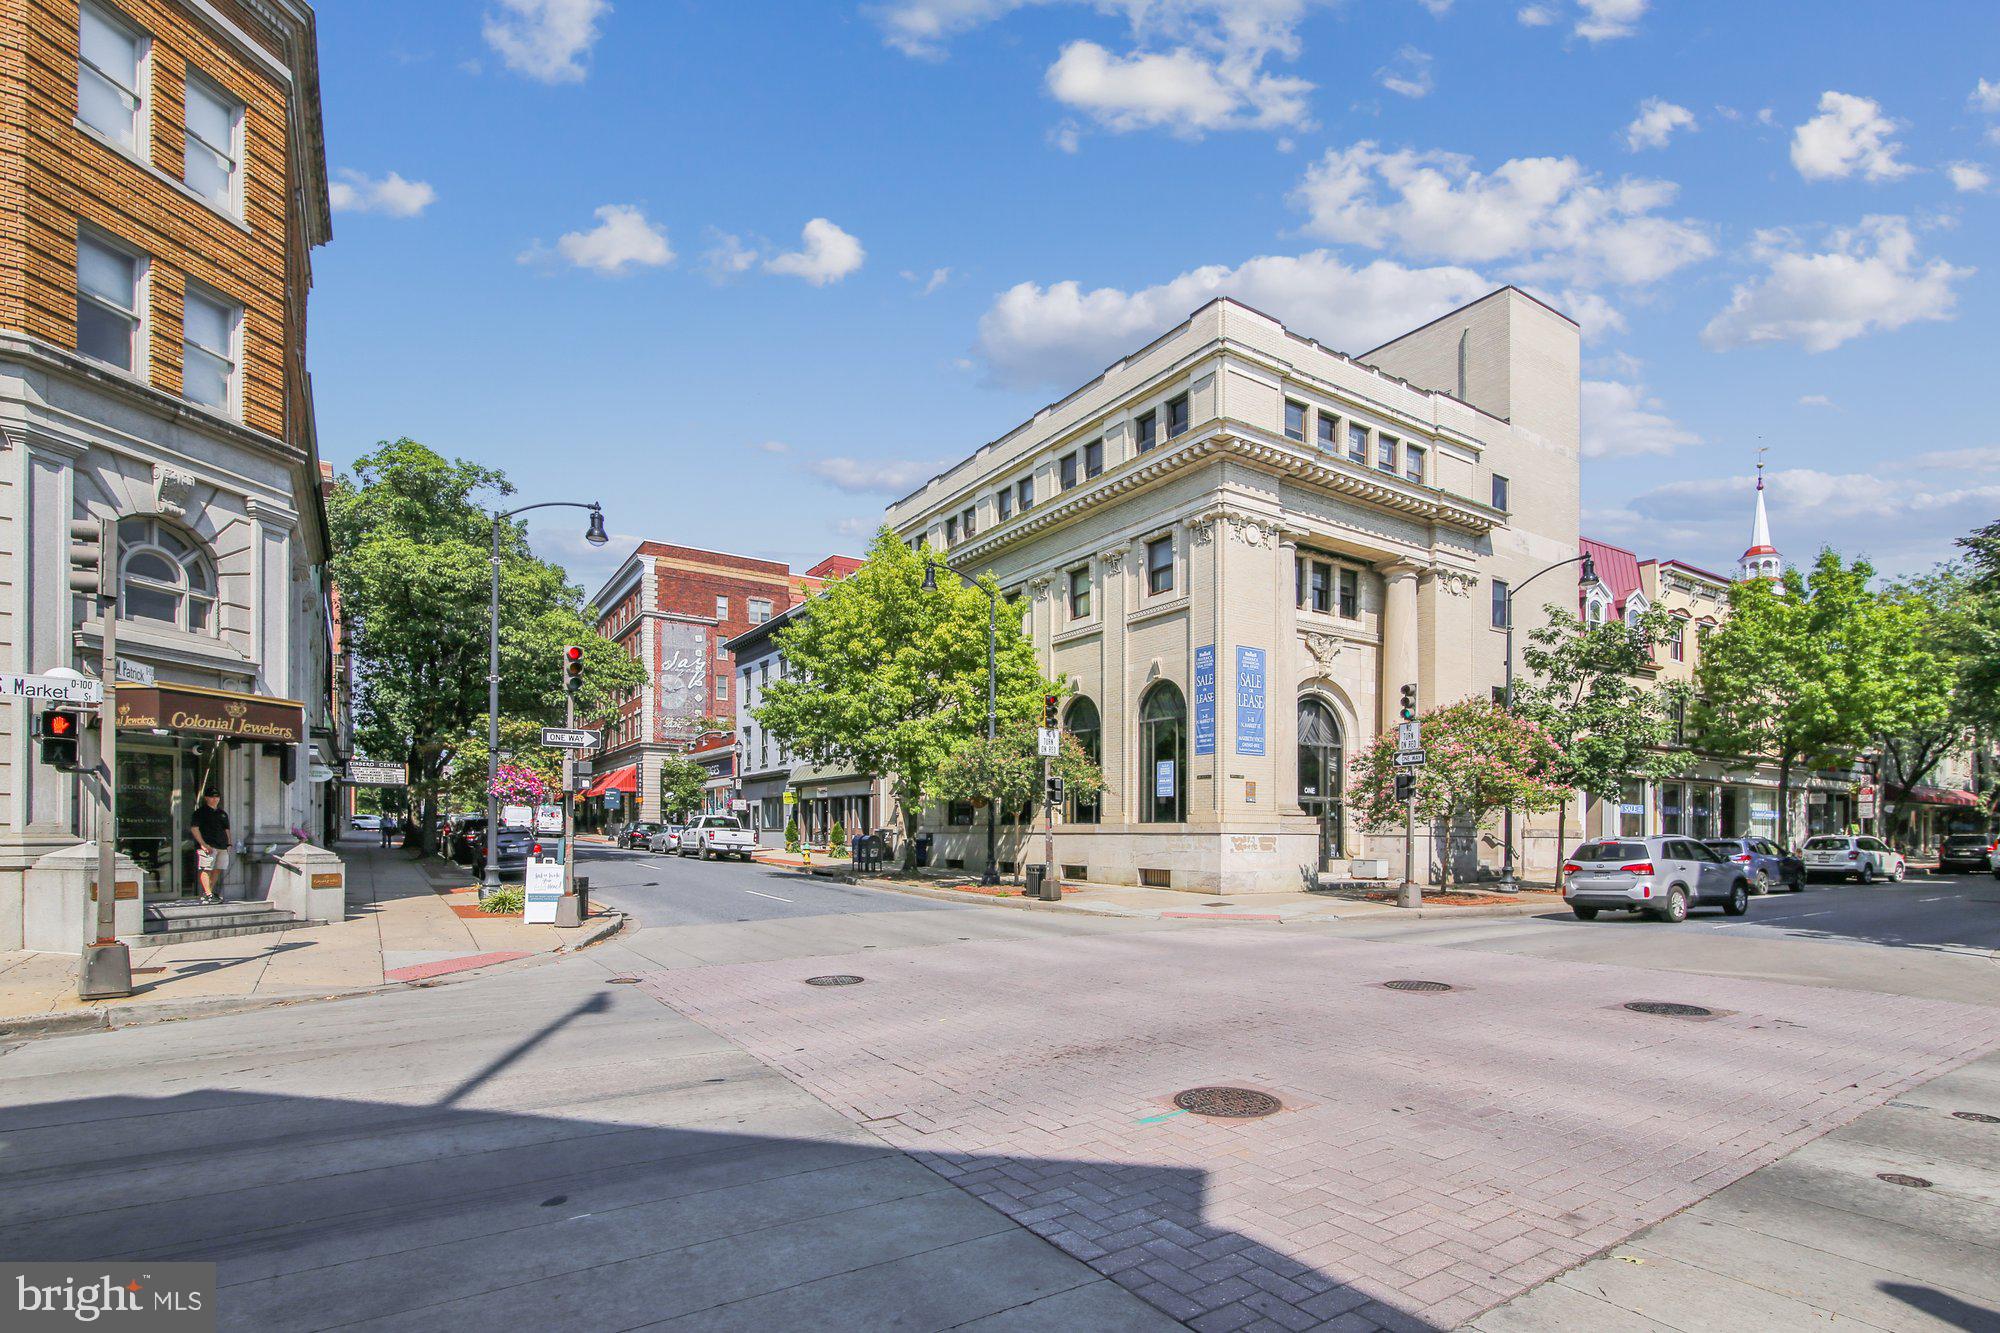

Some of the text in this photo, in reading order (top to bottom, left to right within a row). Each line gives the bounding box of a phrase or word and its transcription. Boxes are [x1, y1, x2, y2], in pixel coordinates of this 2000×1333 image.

[123, 661, 145, 682] Patrick
[71, 679, 93, 690] 0-100
[1196, 673, 1214, 687] SALE
[1240, 672, 1262, 689] SALE
[14, 678, 69, 700] Market
[84, 692, 91, 701] St
[1196, 692, 1215, 704] LEASE
[1238, 693, 1264, 709] LEASE
[124, 715, 155, 726] Jewelers
[171, 711, 293, 739] Colonial Jewelers
[550, 733, 566, 741] ONE
[1624, 804, 1637, 813] SALE
